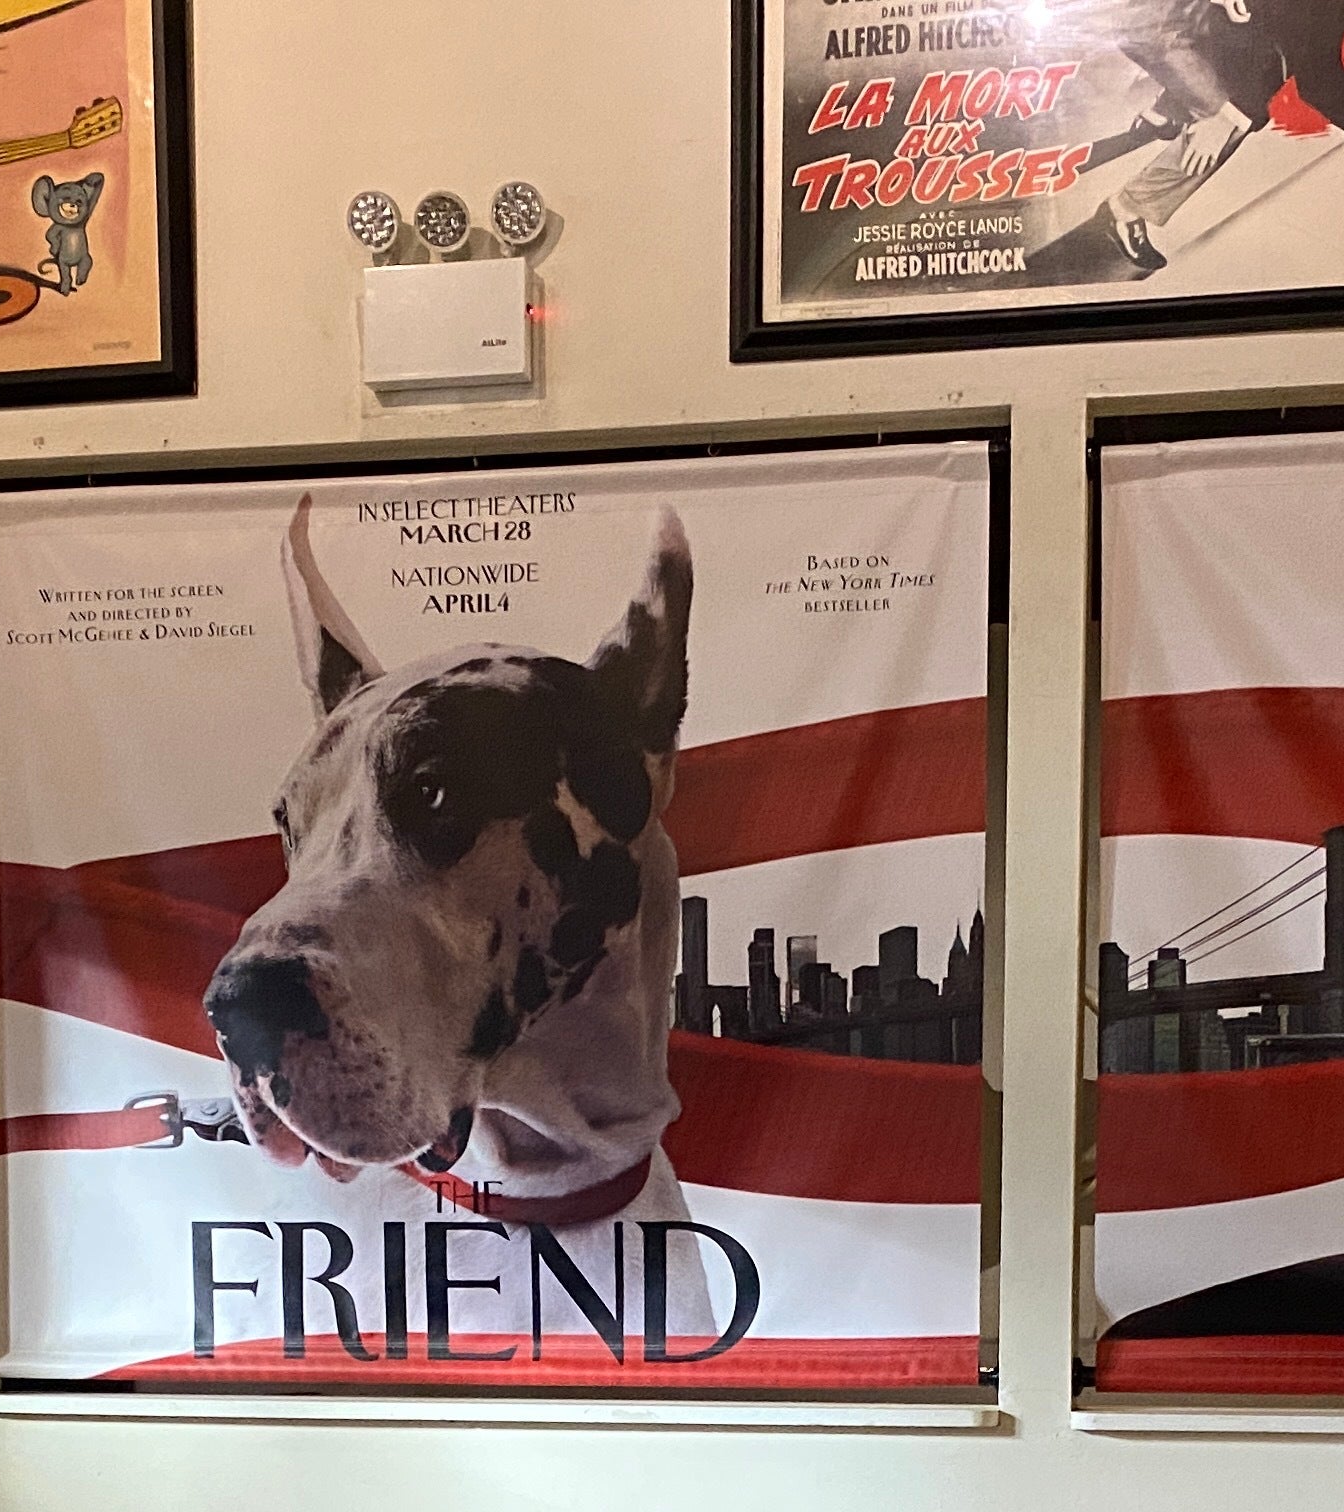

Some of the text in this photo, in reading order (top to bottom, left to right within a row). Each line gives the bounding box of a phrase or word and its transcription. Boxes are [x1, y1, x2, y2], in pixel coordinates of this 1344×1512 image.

[881, 5, 913, 19] DANS
[921, 3, 938, 16] UN
[945, 0, 974, 14] FILM
[825, 23, 911, 61] ALFRED
[808, 61, 1083, 134] LA MORT
[895, 118, 986, 159] AUX
[792, 142, 1093, 213] TROUSSES
[919, 210, 956, 220] AVEC
[853, 214, 1024, 244] JESSIE ROYCE LANDIS
[963, 239, 981, 250] DE
[855, 246, 1028, 282] ALFRED HITCHCOCK
[358, 492, 577, 524] IN SELECT THEATERS
[400, 521, 532, 546] MARCH 28
[866, 555, 890, 568] ON
[391, 562, 540, 589] NATIONWIDE
[765, 581, 791, 594] THE
[107, 588, 135, 602] FOR
[140, 586, 165, 599] THE
[170, 584, 224, 598] SCREEN
[422, 591, 509, 615] APRIL 4
[804, 597, 891, 613] BESTSELLER
[68, 606, 194, 623] AND DIRECTED BY
[139, 628, 150, 641] &
[428, 1181, 504, 1214] THE
[190, 1220, 762, 1366] FRIEND
